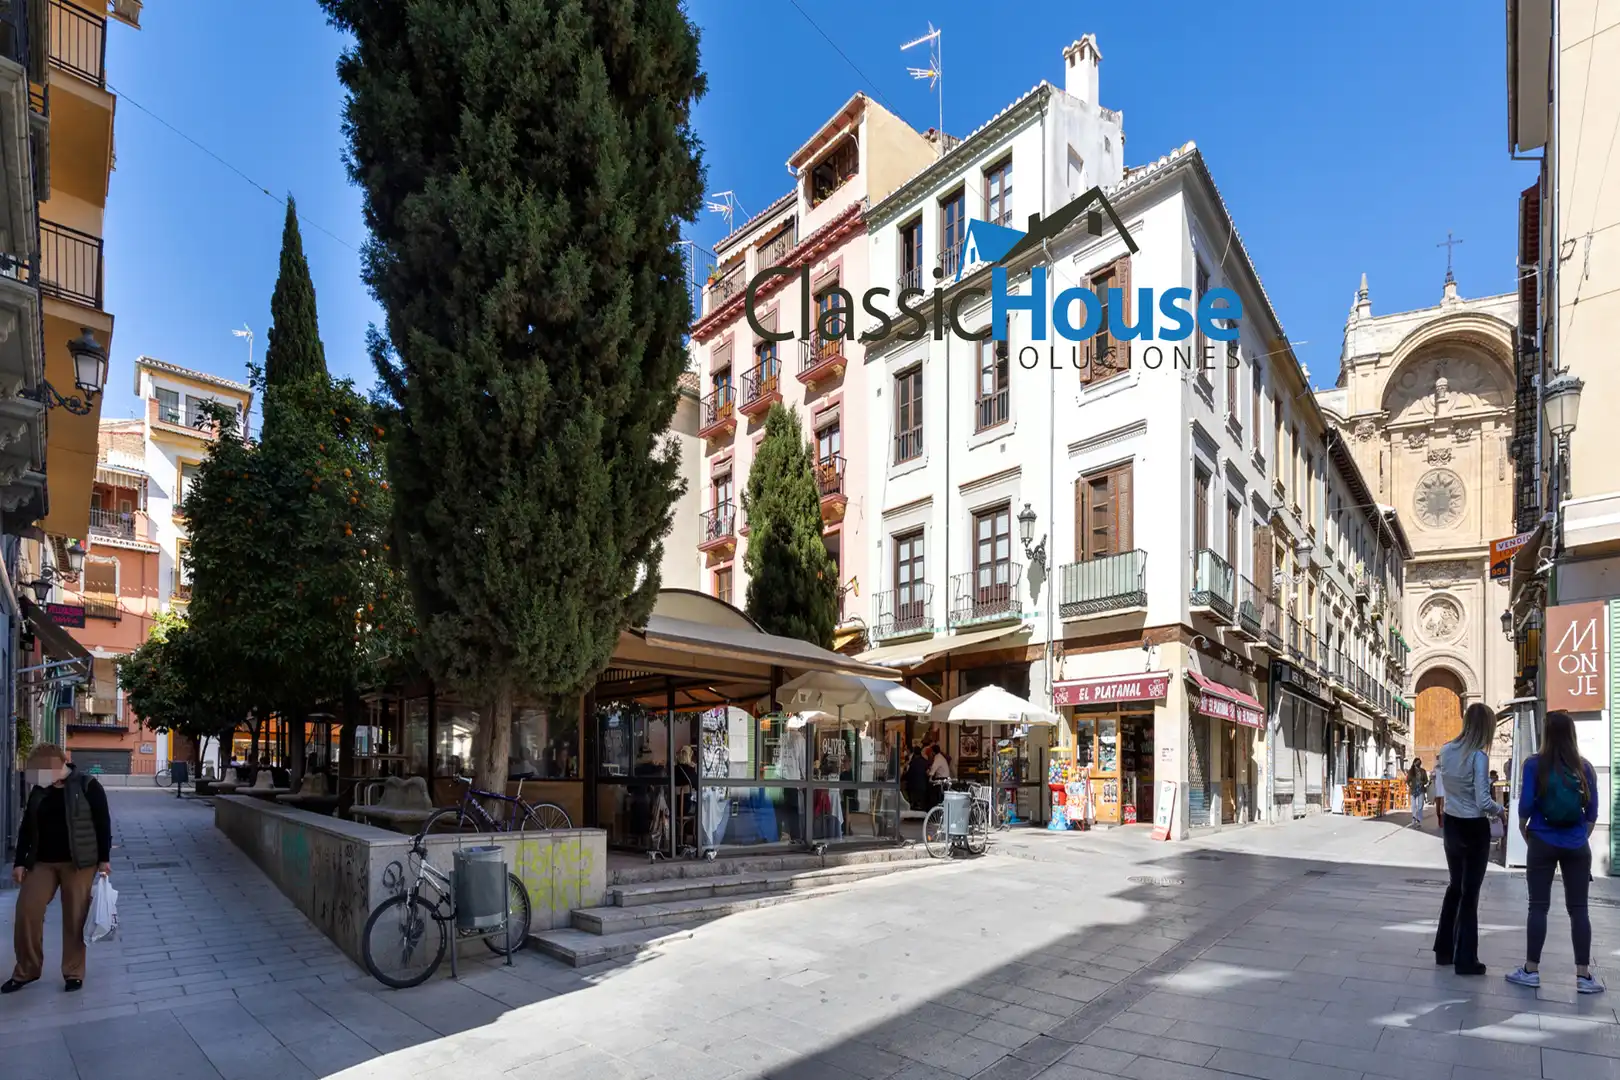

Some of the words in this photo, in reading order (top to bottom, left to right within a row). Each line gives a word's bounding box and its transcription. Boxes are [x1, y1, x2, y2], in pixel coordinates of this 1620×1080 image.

[1079, 687, 1090, 701] EL
[1094, 682, 1142, 700] PLATANAL
[822, 738, 846, 756] OLIVER
